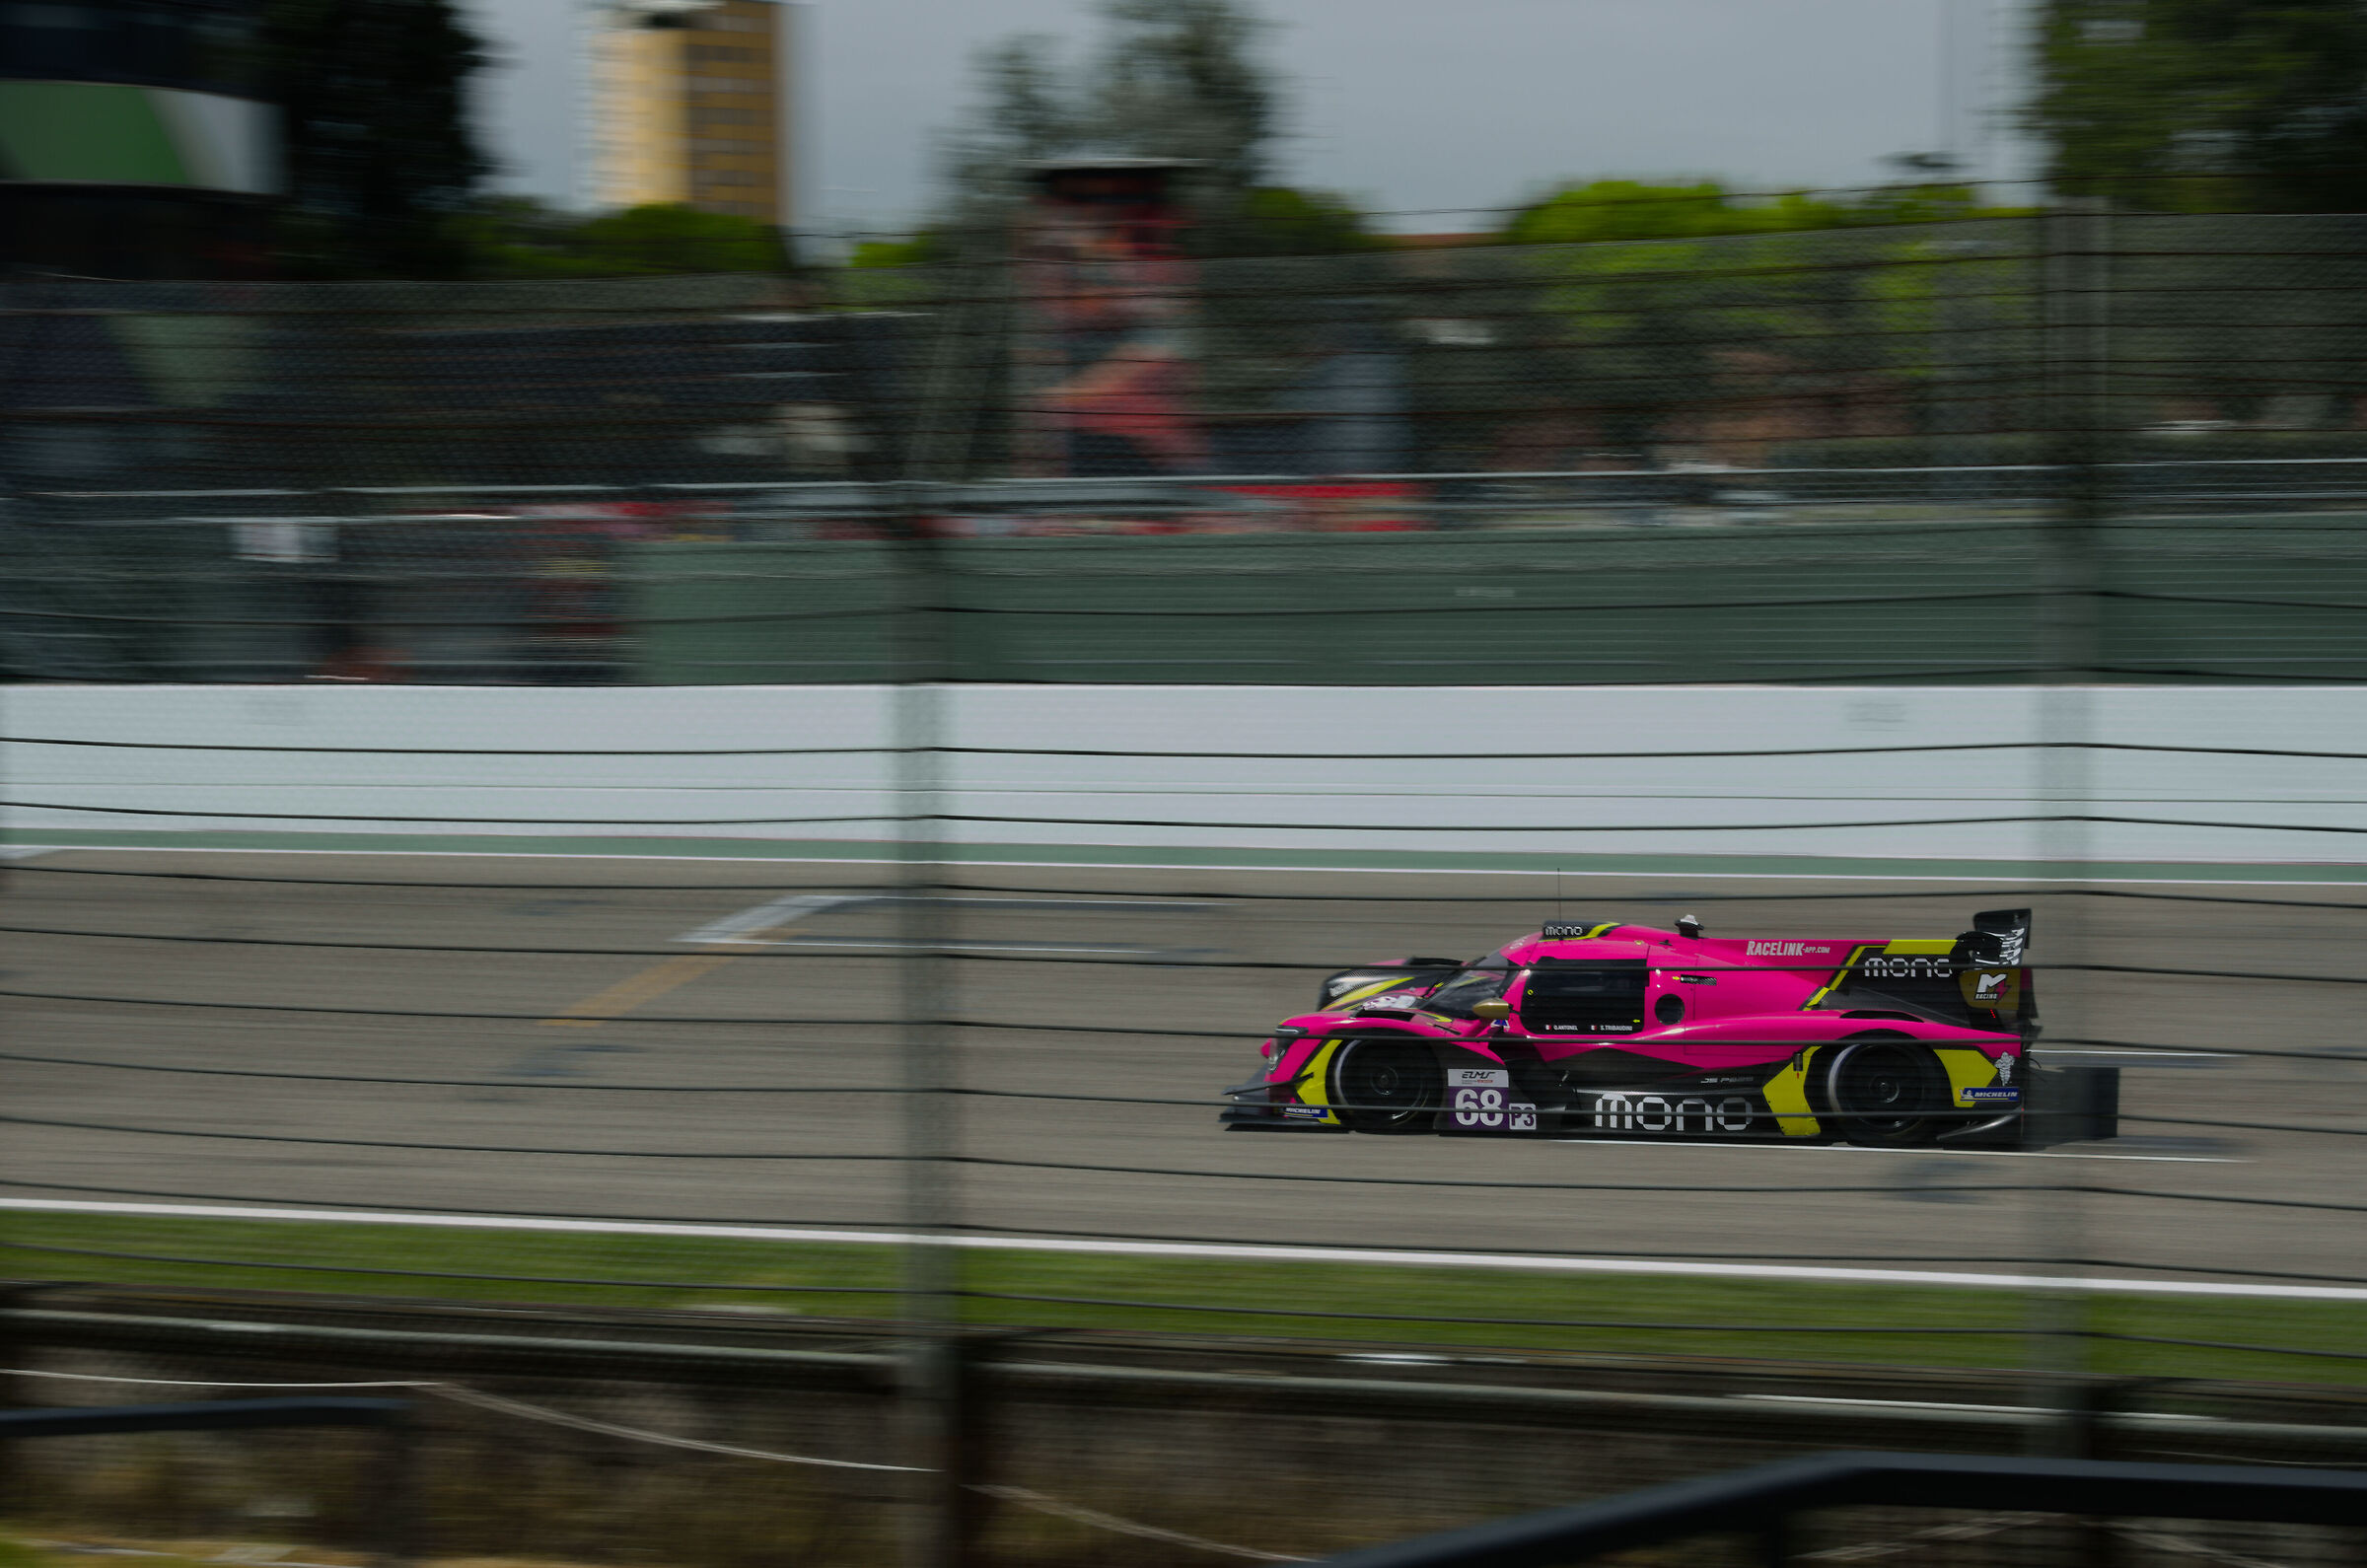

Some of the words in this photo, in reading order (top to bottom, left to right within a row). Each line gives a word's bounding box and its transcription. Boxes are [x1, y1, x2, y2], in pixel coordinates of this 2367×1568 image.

[1455, 1089, 1504, 1126] 68
[1510, 1106, 1535, 1126] P3
[1595, 1093, 1754, 1131] mono
